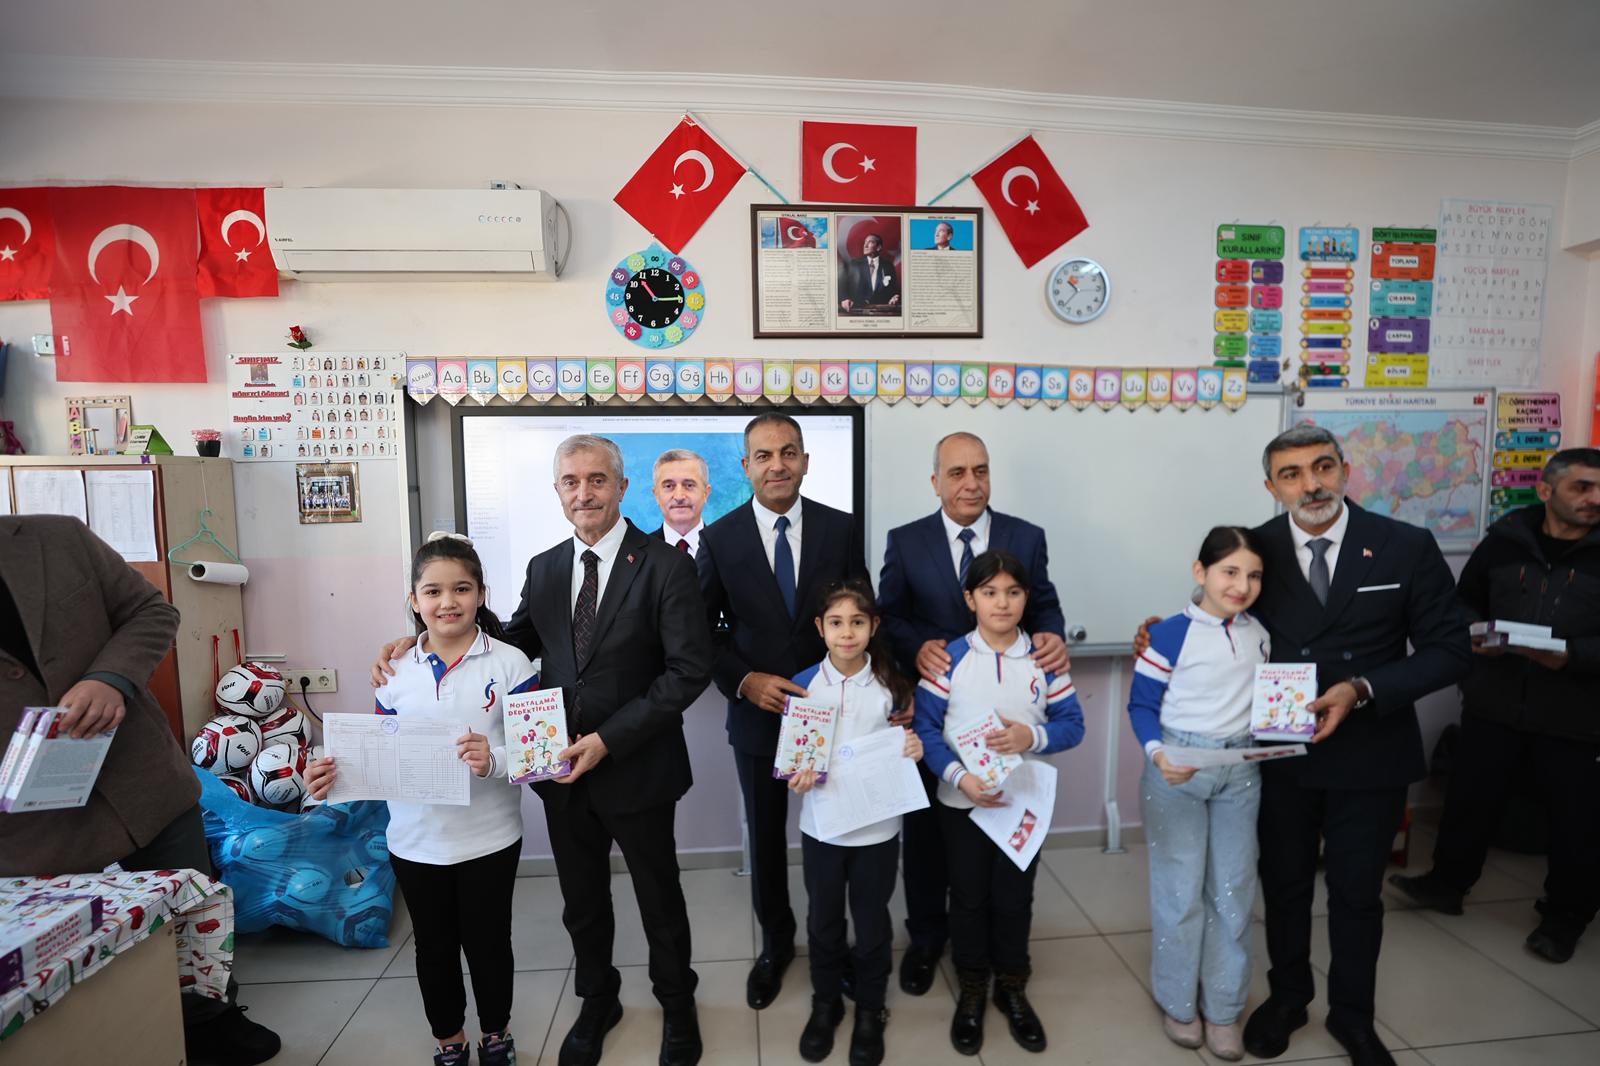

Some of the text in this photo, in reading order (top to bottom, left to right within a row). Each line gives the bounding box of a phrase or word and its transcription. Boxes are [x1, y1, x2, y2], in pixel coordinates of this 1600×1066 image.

[1241, 232, 1262, 241] SINIF
[1222, 245, 1282, 256] KURALLARIMIZ
[614, 272, 624, 281] 50
[685, 275, 694, 285] 10
[630, 280, 638, 288] 10
[411, 371, 432, 384] ALFABE
[442, 370, 462, 384] Aa
[474, 370, 490, 384] Bb
[502, 370, 521, 384] Cc
[532, 370, 551, 386] Çç
[562, 370, 581, 383] Dd
[594, 370, 610, 384] Ee
[624, 370, 638, 383] Ff
[650, 369, 670, 386] Gg
[710, 372, 728, 384] Hh
[800, 371, 814, 389] Jj
[827, 372, 842, 385] Kk
[856, 372, 868, 385] Ll
[880, 374, 901, 384] Mm
[910, 374, 928, 386] Nn
[938, 374, 956, 386] Oo
[965, 372, 984, 388] Öö
[994, 375, 1008, 392] Pp
[1022, 376, 1036, 389] Rr
[1102, 379, 1115, 392] Tt
[1126, 380, 1142, 392] Uu
[1178, 380, 1192, 392] Vv
[1202, 378, 1216, 396] Yy
[1227, 379, 1242, 392] Zz
[1344, 397, 1376, 406] TÜRKİYE
[1526, 436, 1544, 444] DERS
[1523, 455, 1542, 463] DERS
[222, 681, 236, 692] Voit
[510, 698, 555, 708] NOKTALAMA
[508, 704, 558, 716] DEDEKTİFLERİ
[794, 706, 830, 716] NOKTALAMA
[236, 744, 250, 757] Voit
